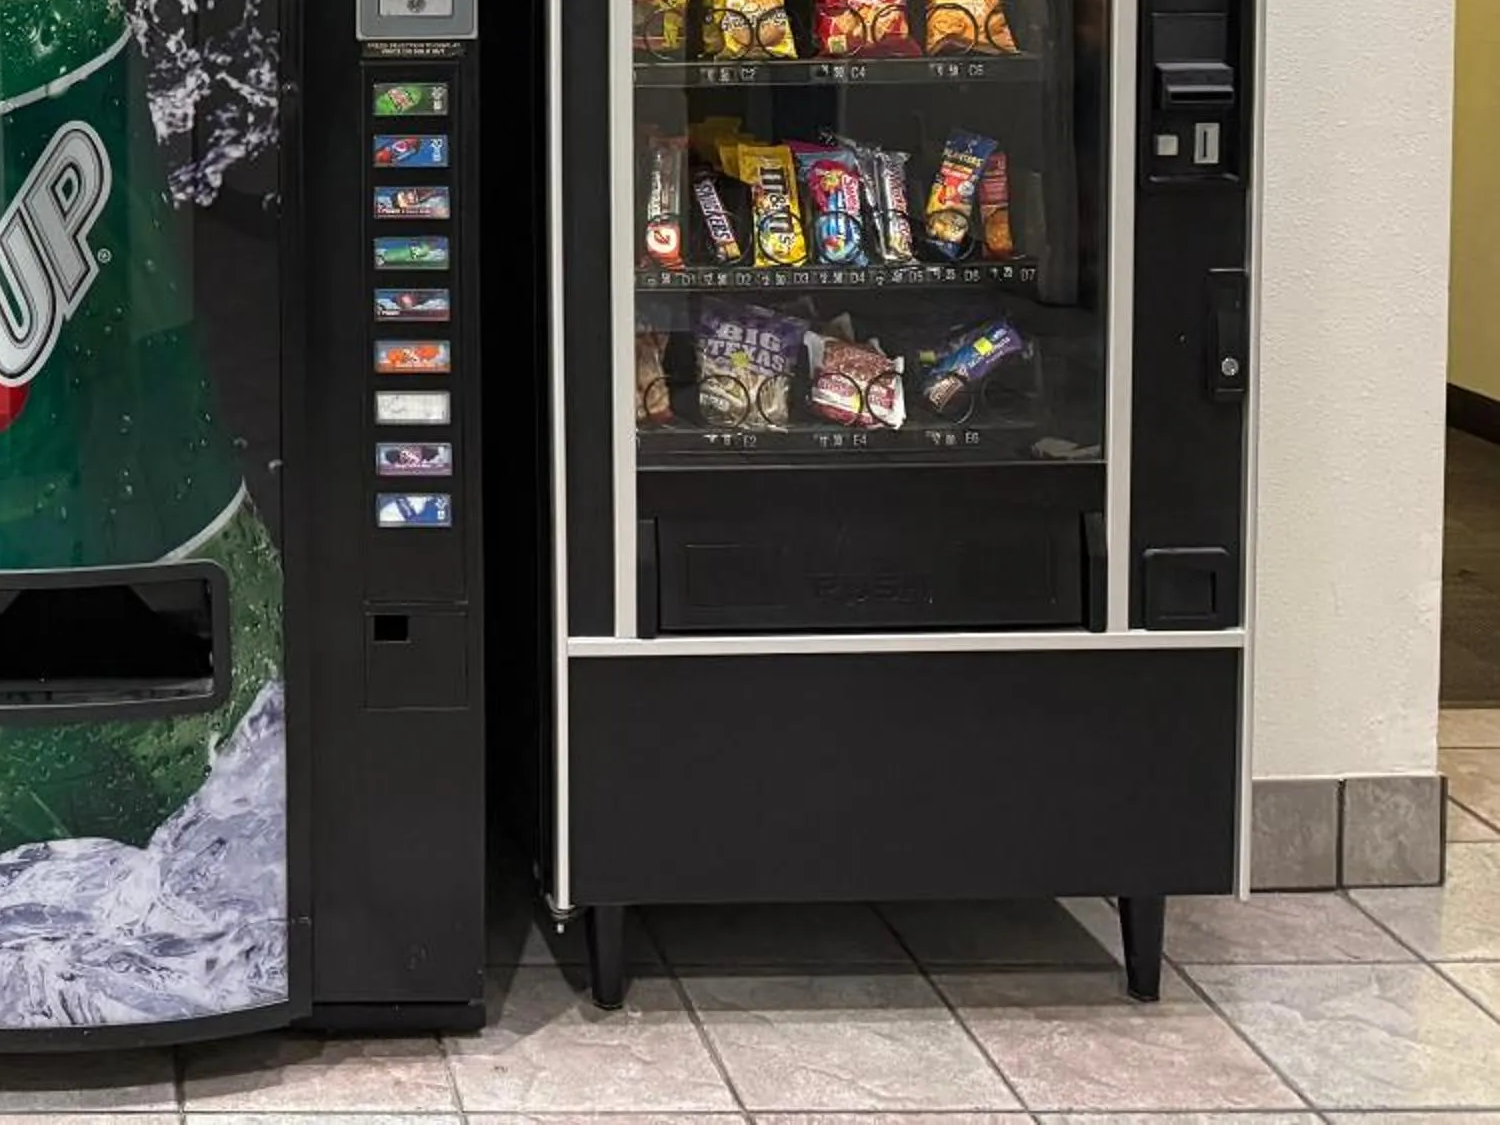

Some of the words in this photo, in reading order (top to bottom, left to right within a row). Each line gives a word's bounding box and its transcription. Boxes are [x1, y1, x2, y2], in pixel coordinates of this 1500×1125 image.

[693, 177, 736, 247] SNICKERS
[716, 322, 783, 353] BIG
[705, 339, 785, 373] TEXAS
